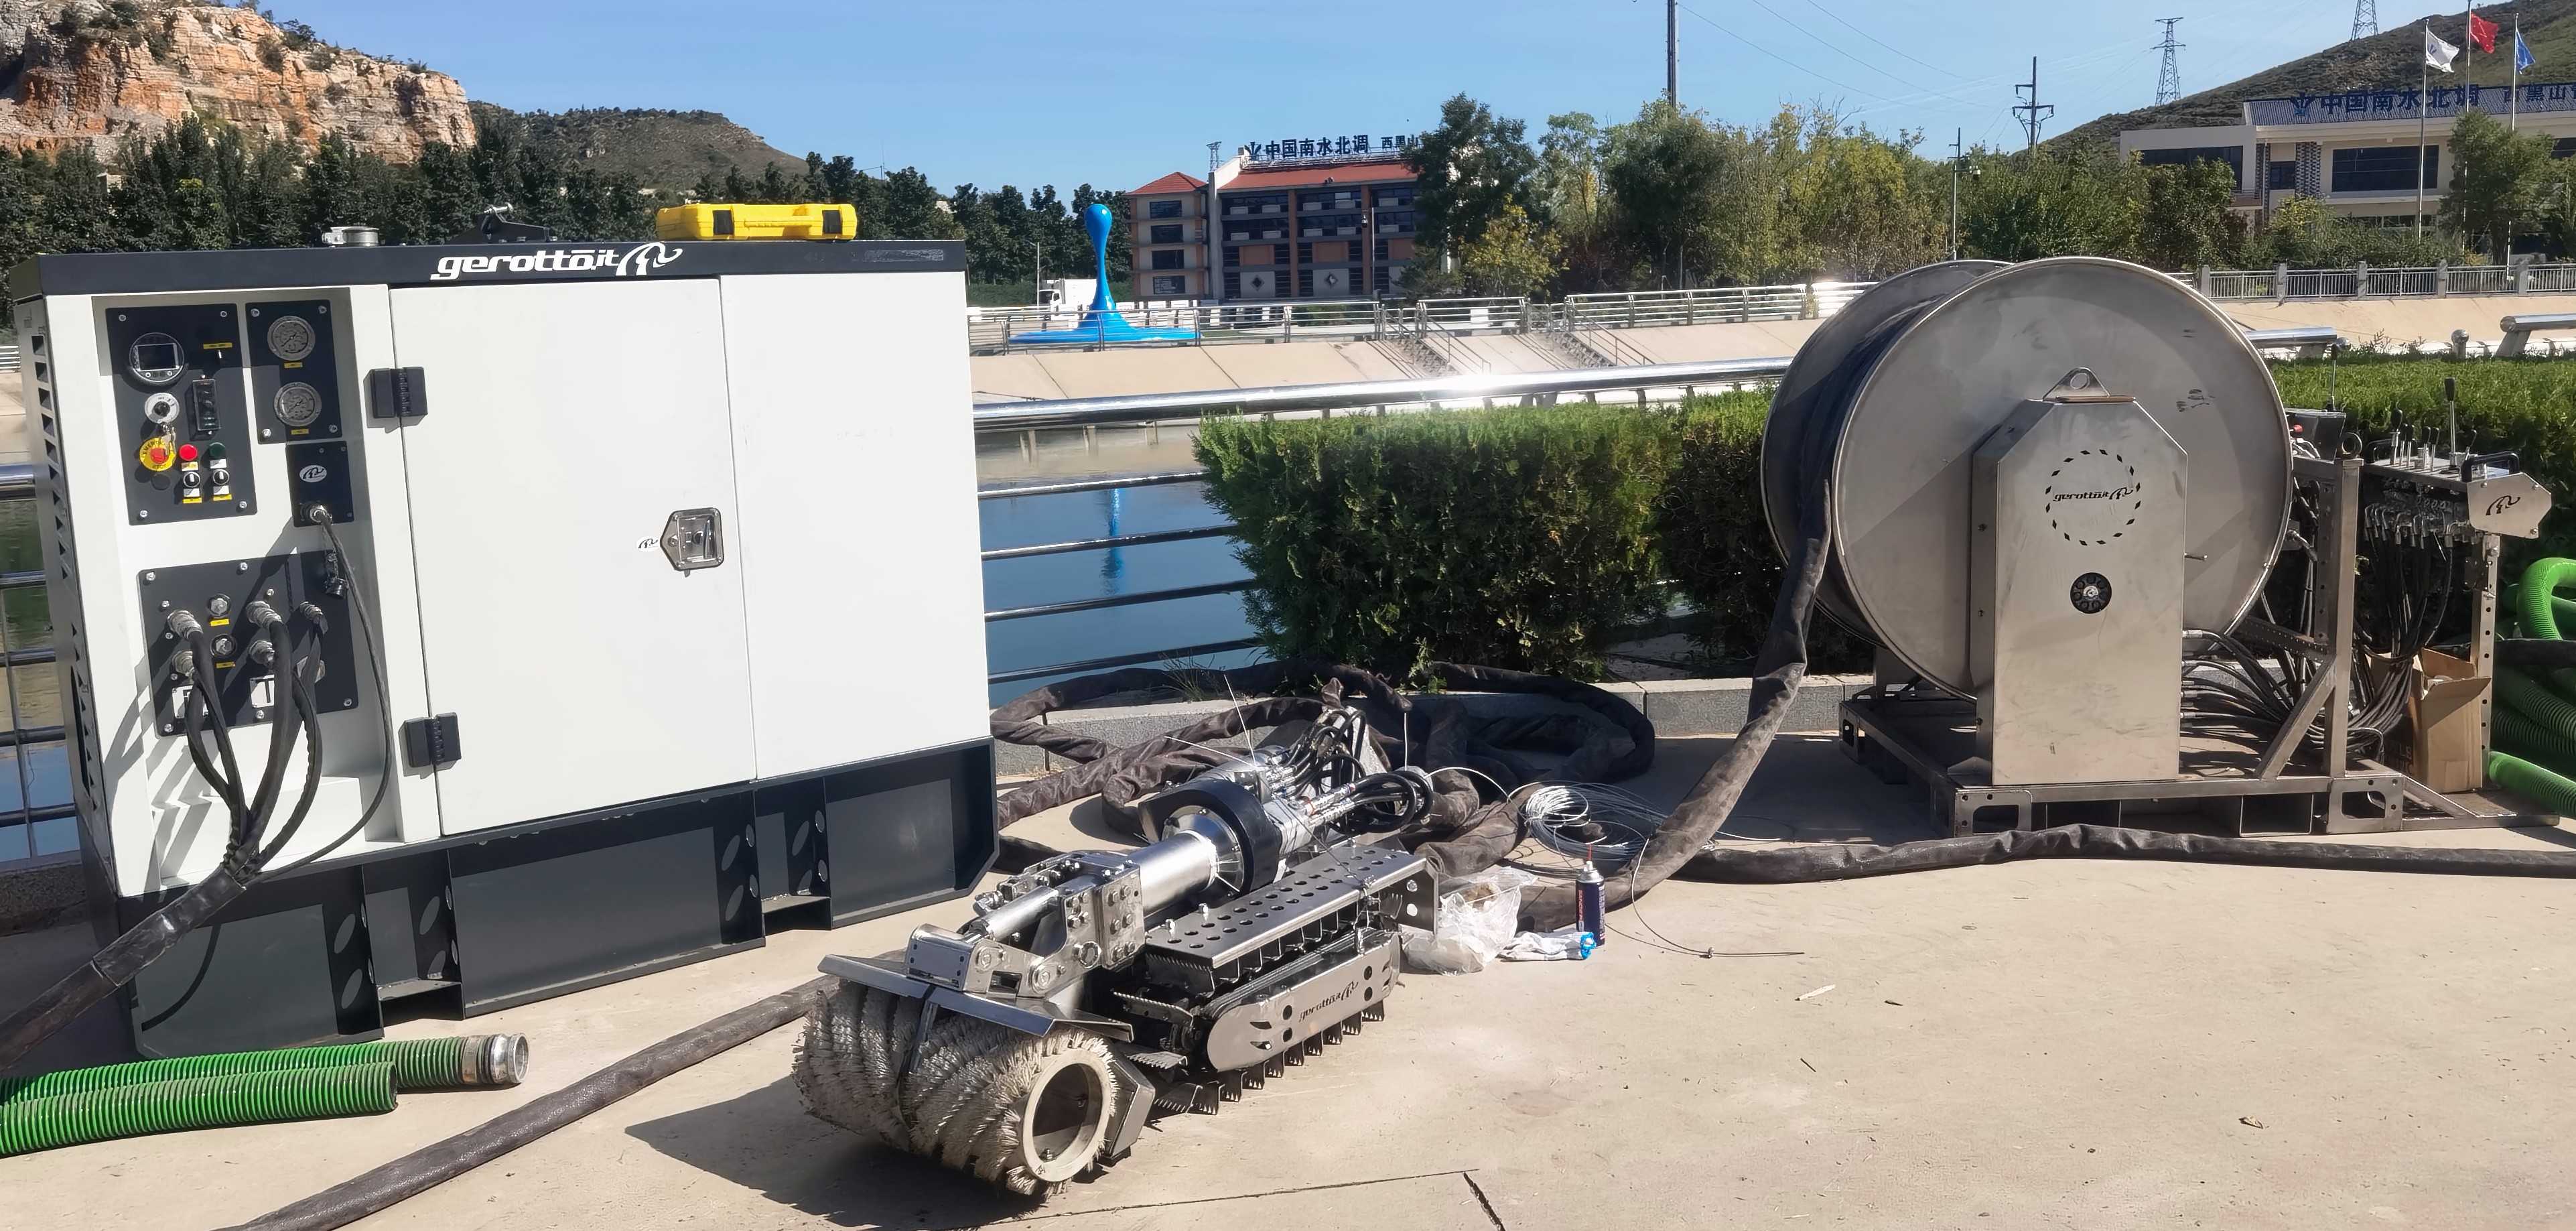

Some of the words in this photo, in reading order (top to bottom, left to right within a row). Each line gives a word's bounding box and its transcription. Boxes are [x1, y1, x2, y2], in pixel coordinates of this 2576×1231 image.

[2321, 84, 2479, 115] 中国南水北调
[1266, 134, 1368, 159] 中国南水北调
